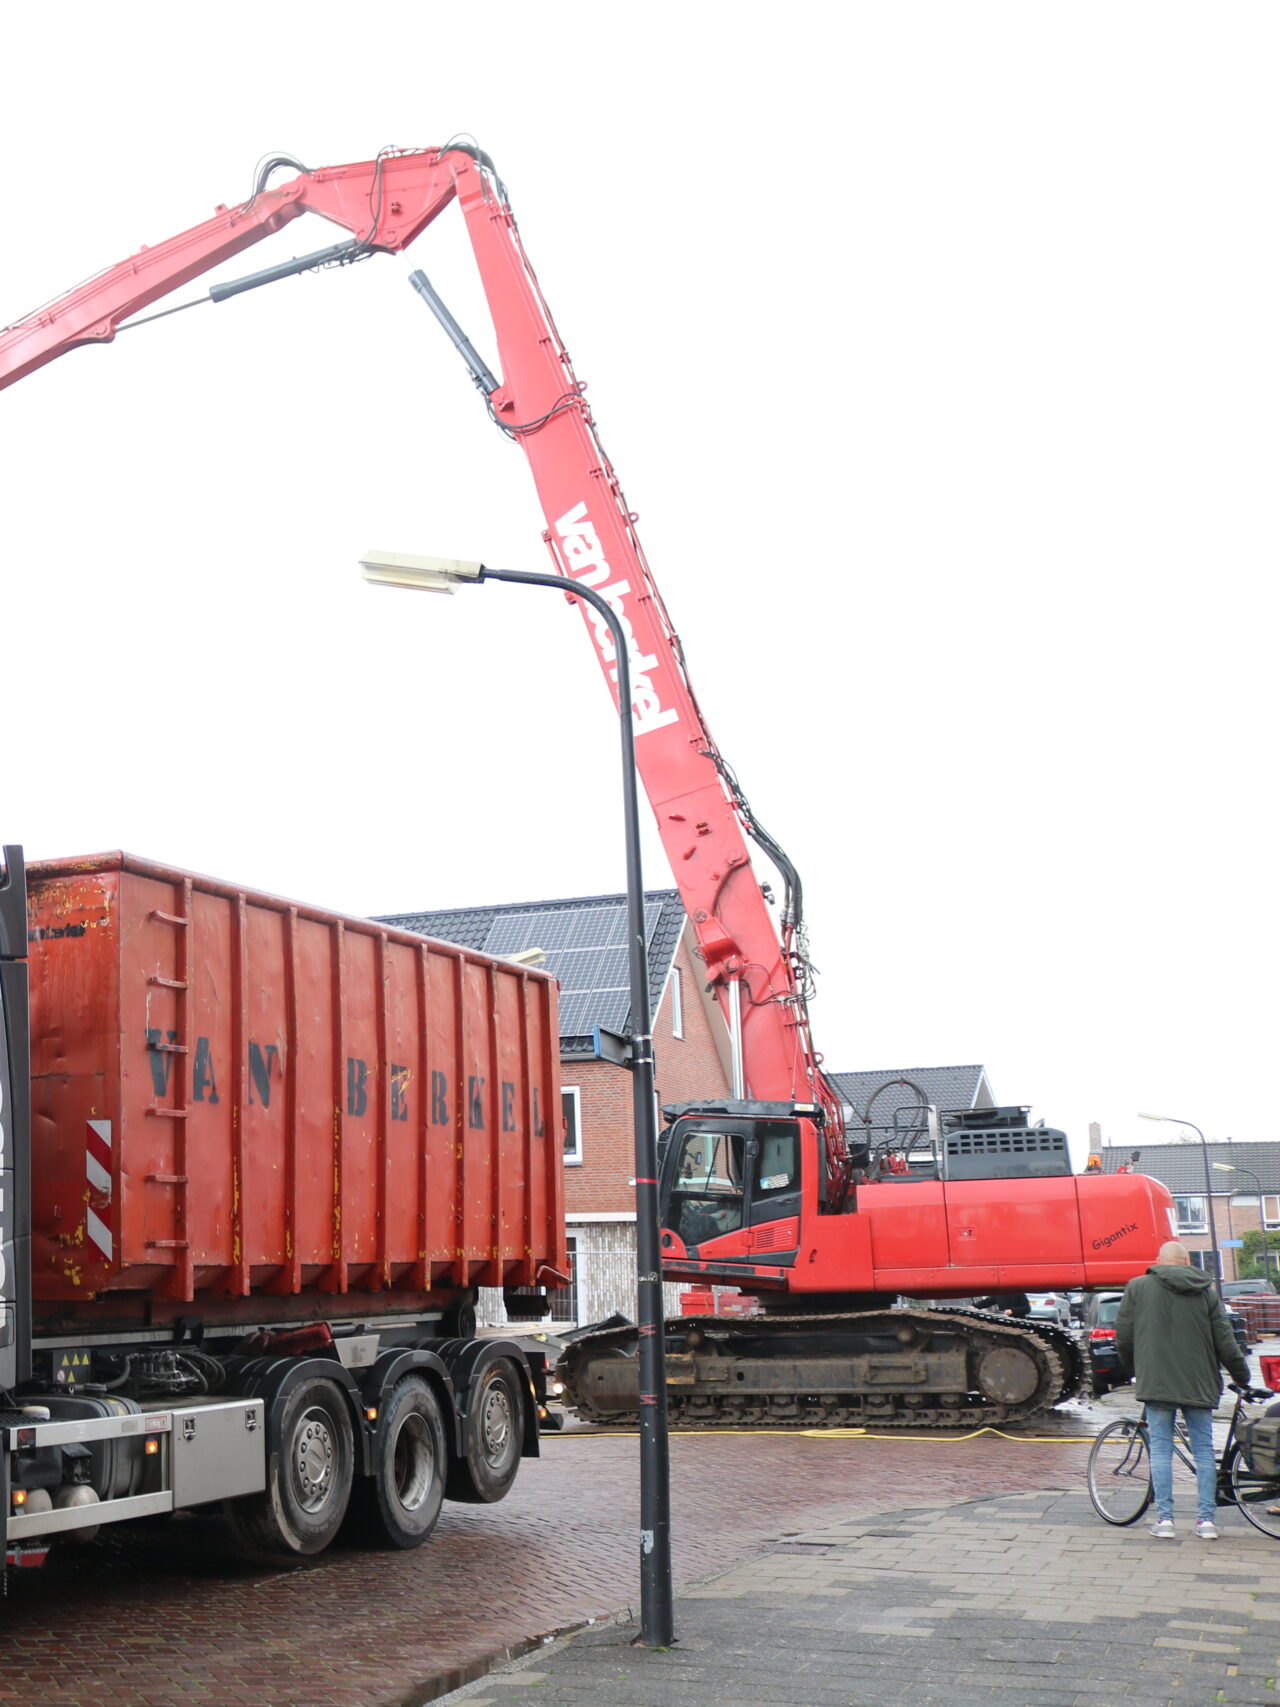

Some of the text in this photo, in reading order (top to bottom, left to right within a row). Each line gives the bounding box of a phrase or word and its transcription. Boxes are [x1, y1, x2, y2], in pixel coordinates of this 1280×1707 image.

[554, 501, 611, 590] van
[145, 1029, 545, 1138] VAN BERKEL
[1091, 1223, 1139, 1251] Gigantix
